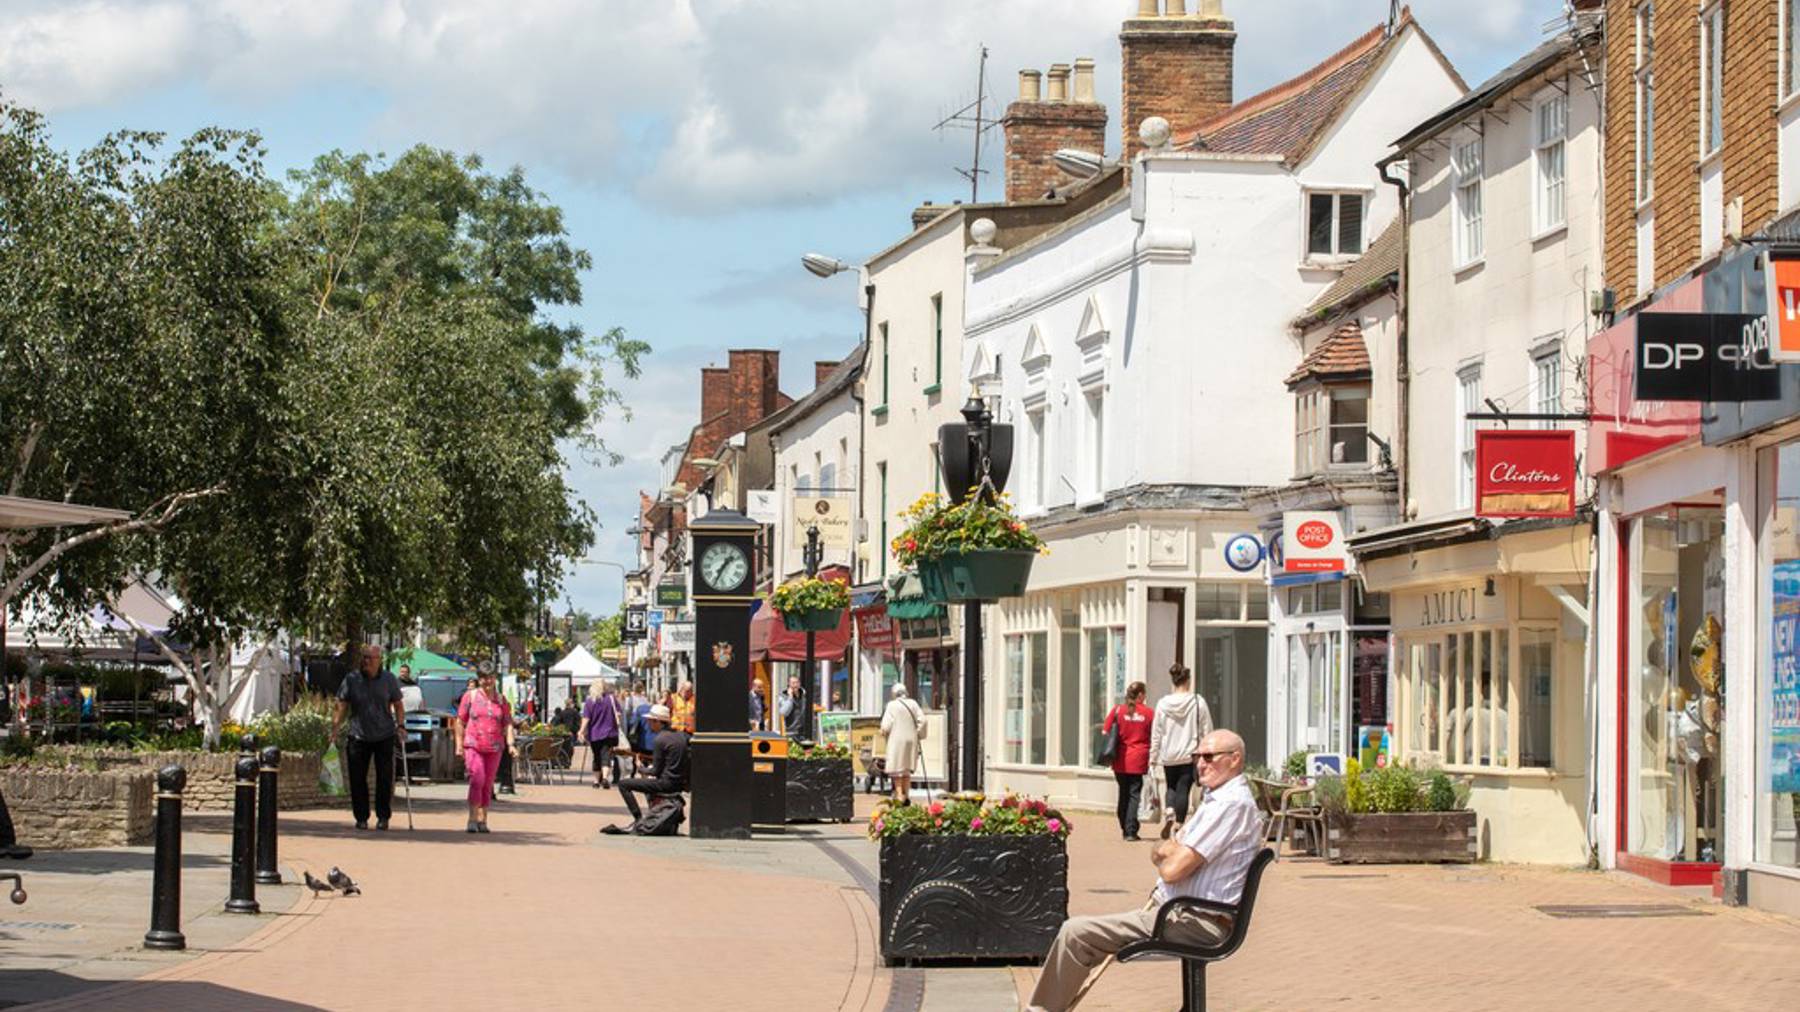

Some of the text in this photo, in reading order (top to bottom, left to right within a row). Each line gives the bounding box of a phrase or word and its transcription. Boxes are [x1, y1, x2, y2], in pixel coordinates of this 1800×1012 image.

[1642, 343, 1704, 369] DP
[1489, 461, 1560, 483] Clintons
[1298, 533, 1329, 543] OFFICE
[1303, 525, 1326, 536] POST
[1421, 587, 1476, 626] AMICI
